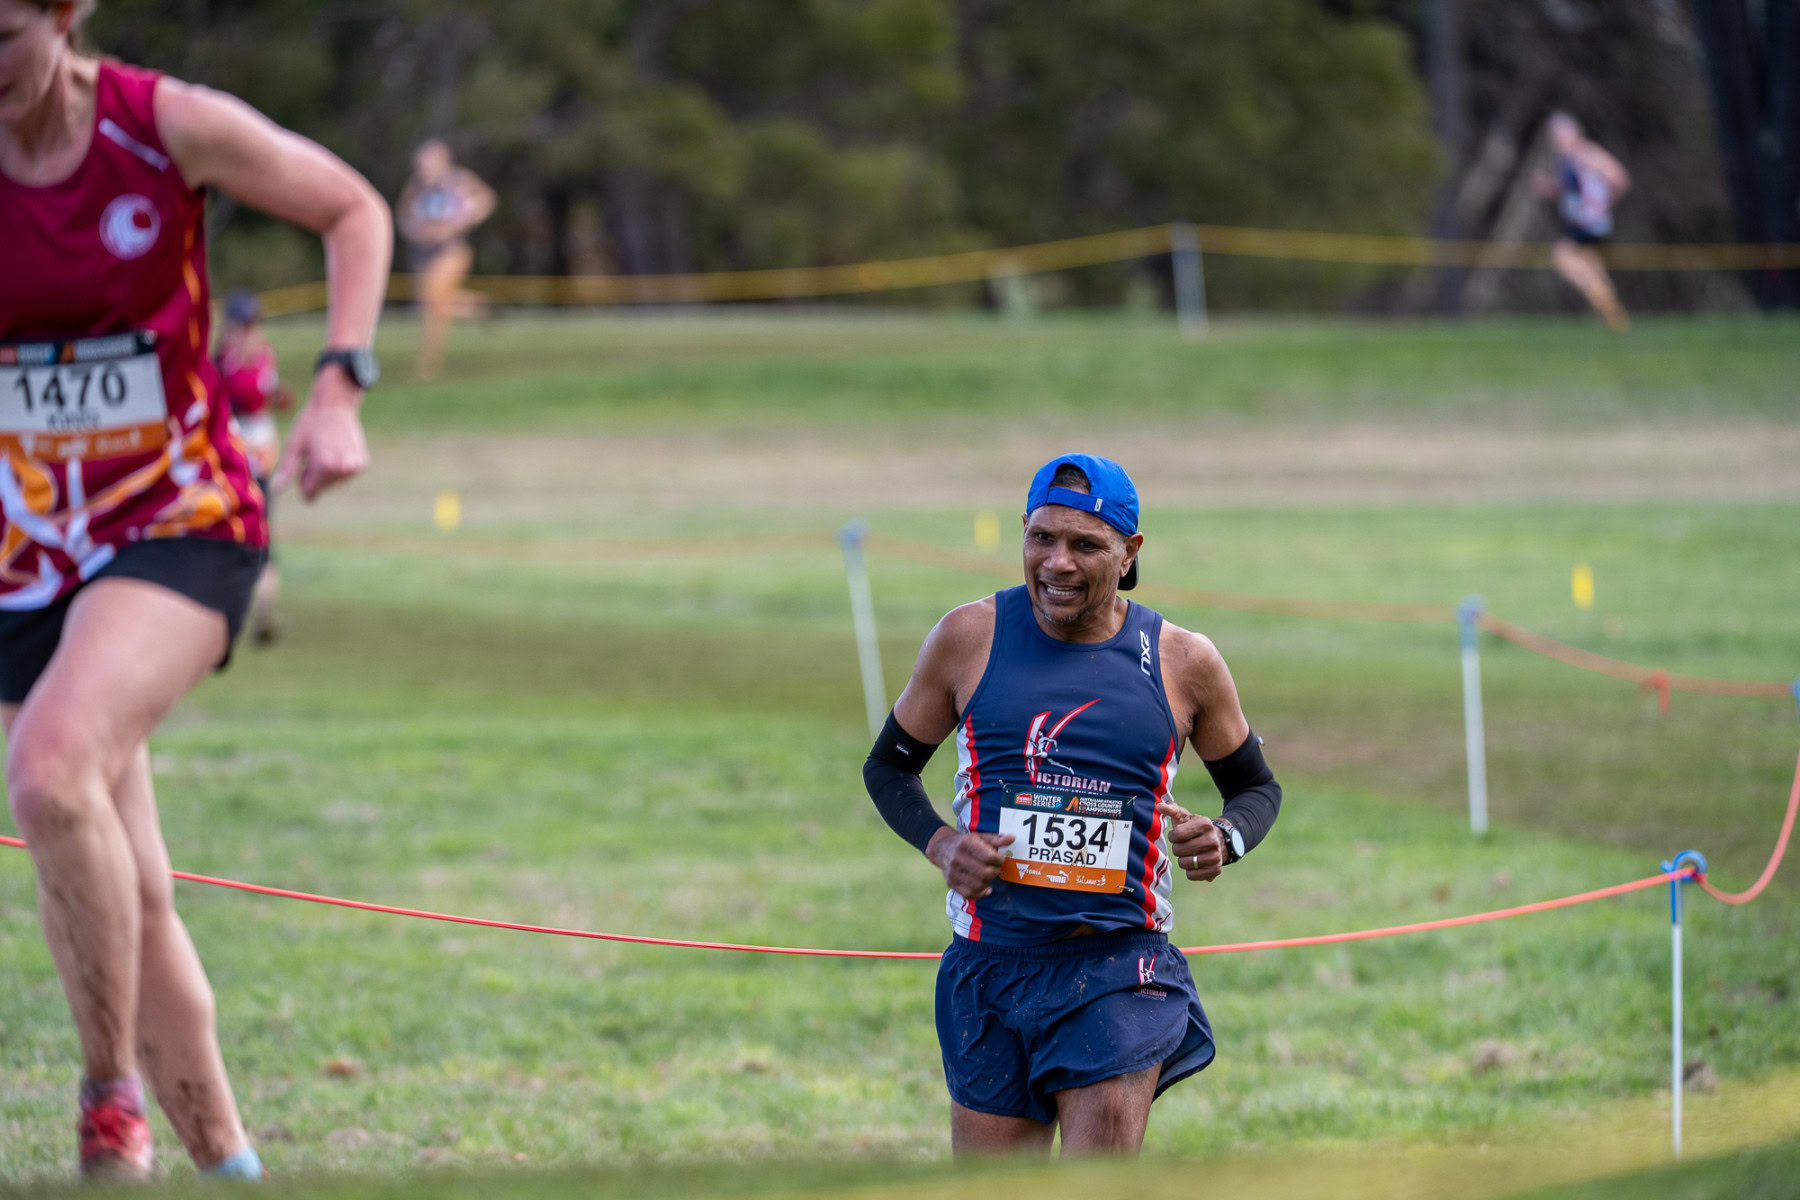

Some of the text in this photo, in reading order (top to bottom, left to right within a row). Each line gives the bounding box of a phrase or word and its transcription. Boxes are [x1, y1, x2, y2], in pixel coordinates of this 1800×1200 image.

[14, 362, 126, 412] 1470
[1140, 630, 1151, 676] 2XU
[1032, 800, 1056, 809] SERIES
[1033, 793, 1062, 803] WINTER
[1023, 814, 1109, 853] 1534
[1028, 847, 1097, 865] PRASAD
[1046, 874, 1066, 884] PUMA
